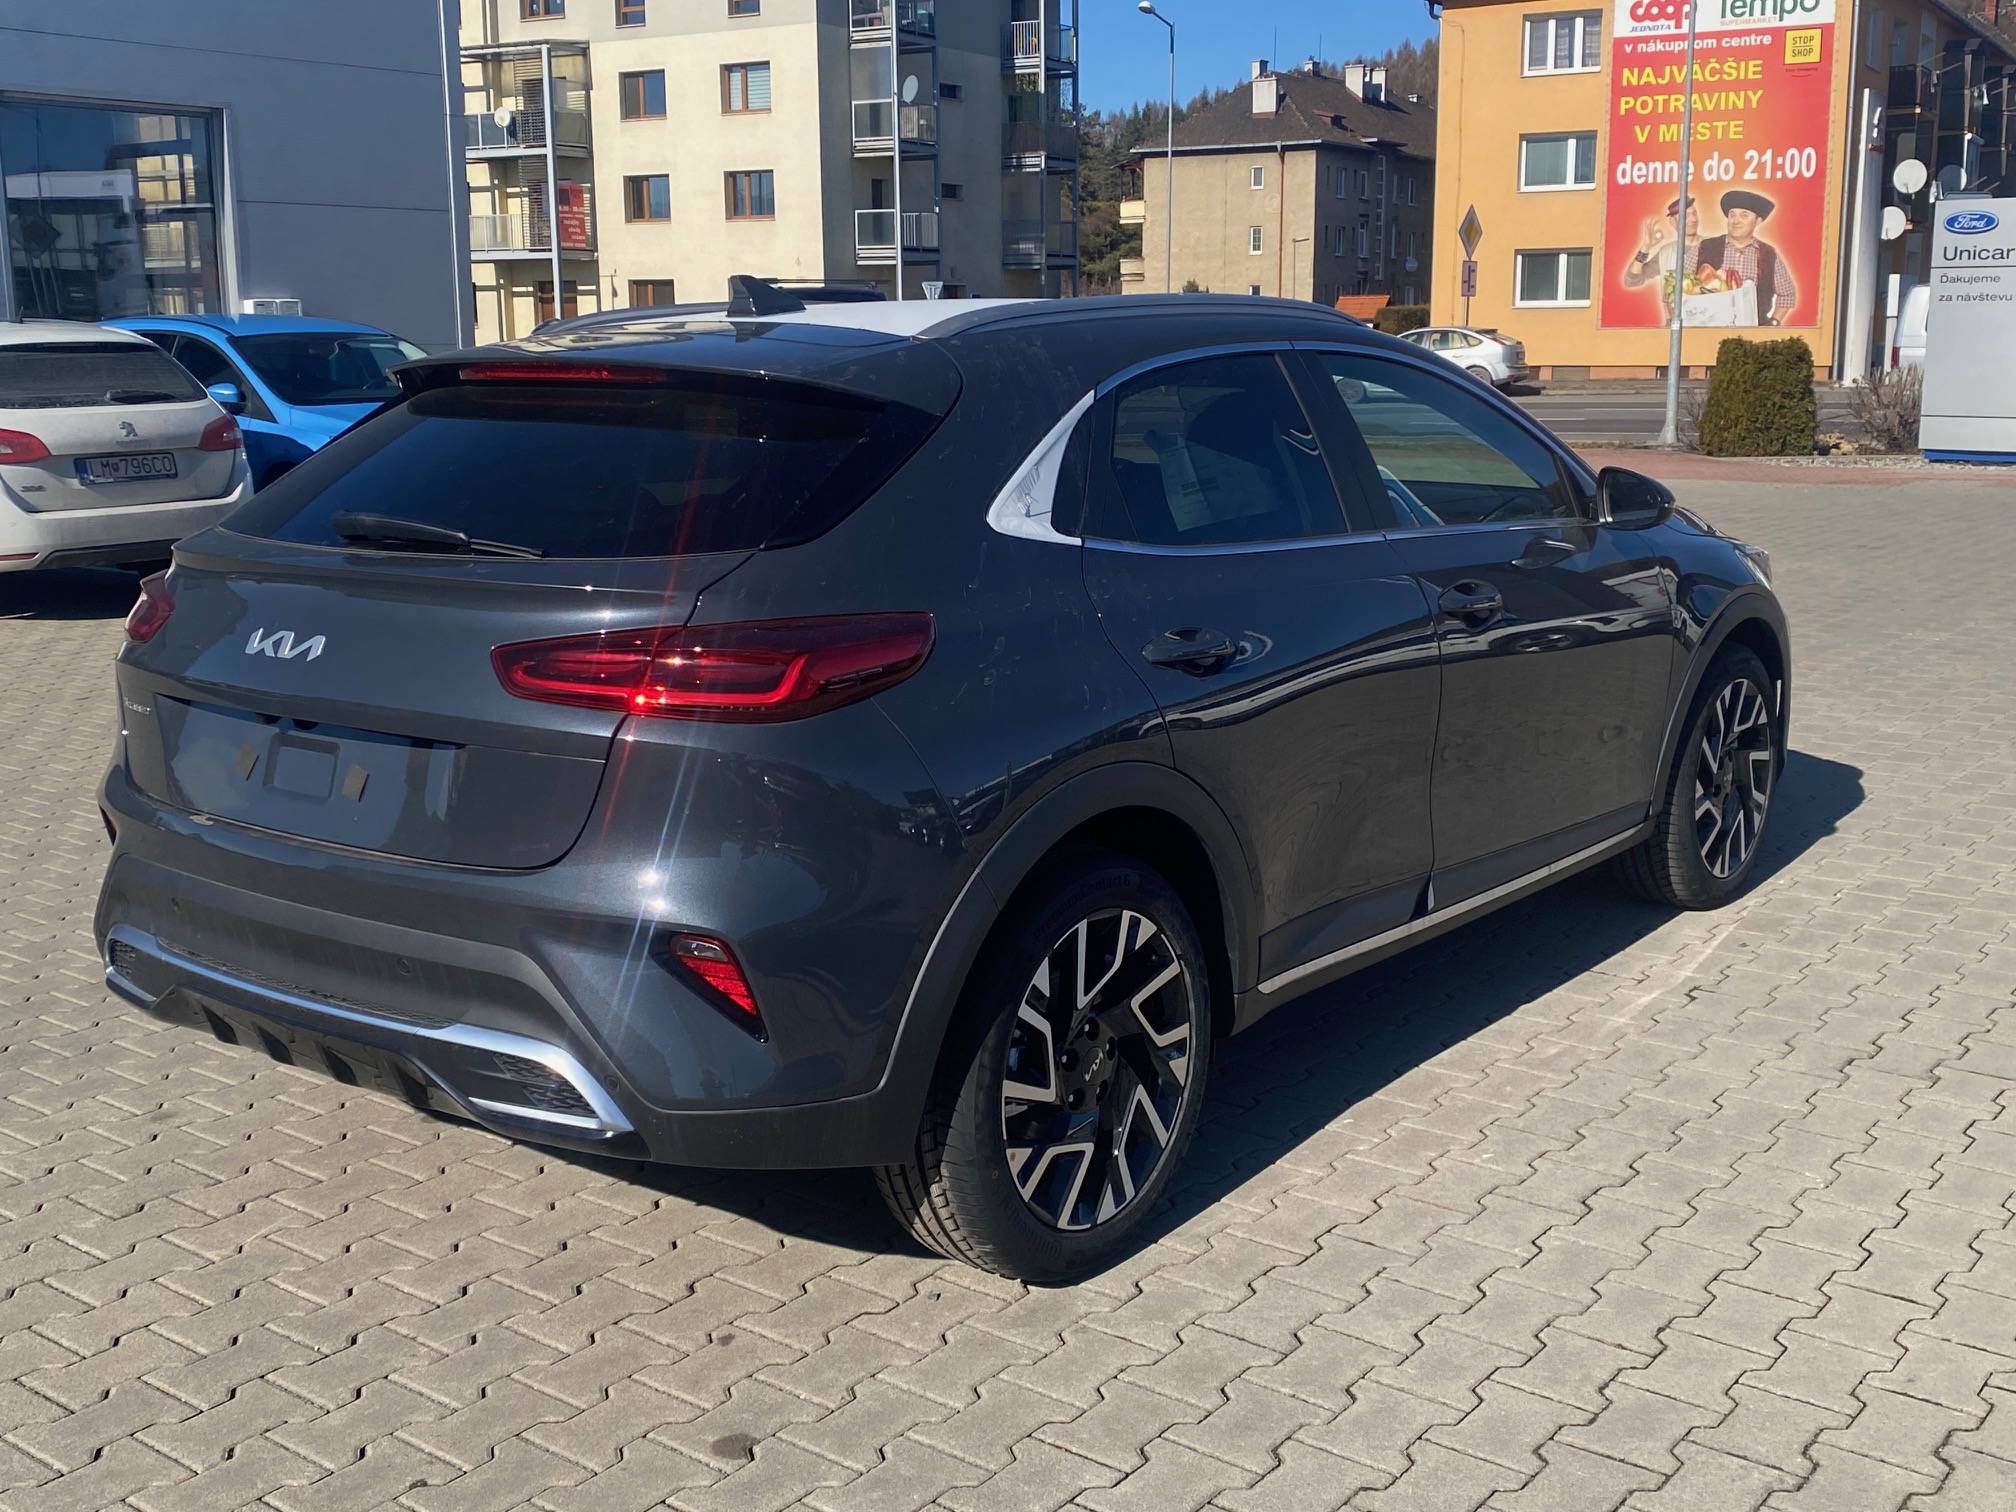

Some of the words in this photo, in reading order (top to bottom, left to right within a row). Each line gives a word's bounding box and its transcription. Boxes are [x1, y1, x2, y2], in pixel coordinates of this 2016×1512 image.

[1629, 24, 1671, 33] JEDNOTA
[1720, 16, 1778, 26] SUPERMARKET
[1624, 43, 1633, 53] v
[1721, 33, 1772, 48] centre
[1792, 35, 1815, 46] STOP
[1791, 47, 1814, 58] SHOP
[1622, 57, 1763, 86] NAJVÄČŠIE
[1619, 89, 1764, 115] POTRAVINY
[1634, 125, 1651, 144] V
[1703, 151, 1735, 182] do
[1743, 147, 1817, 180] 21:00
[1954, 214, 1987, 228] Ford
[1943, 245, 2015, 261] Unicar
[1940, 273, 2001, 285] Ďakujeme
[1938, 294, 1953, 302] za
[1956, 291, 2013, 302] návštevu
[88, 459, 112, 479] LM
